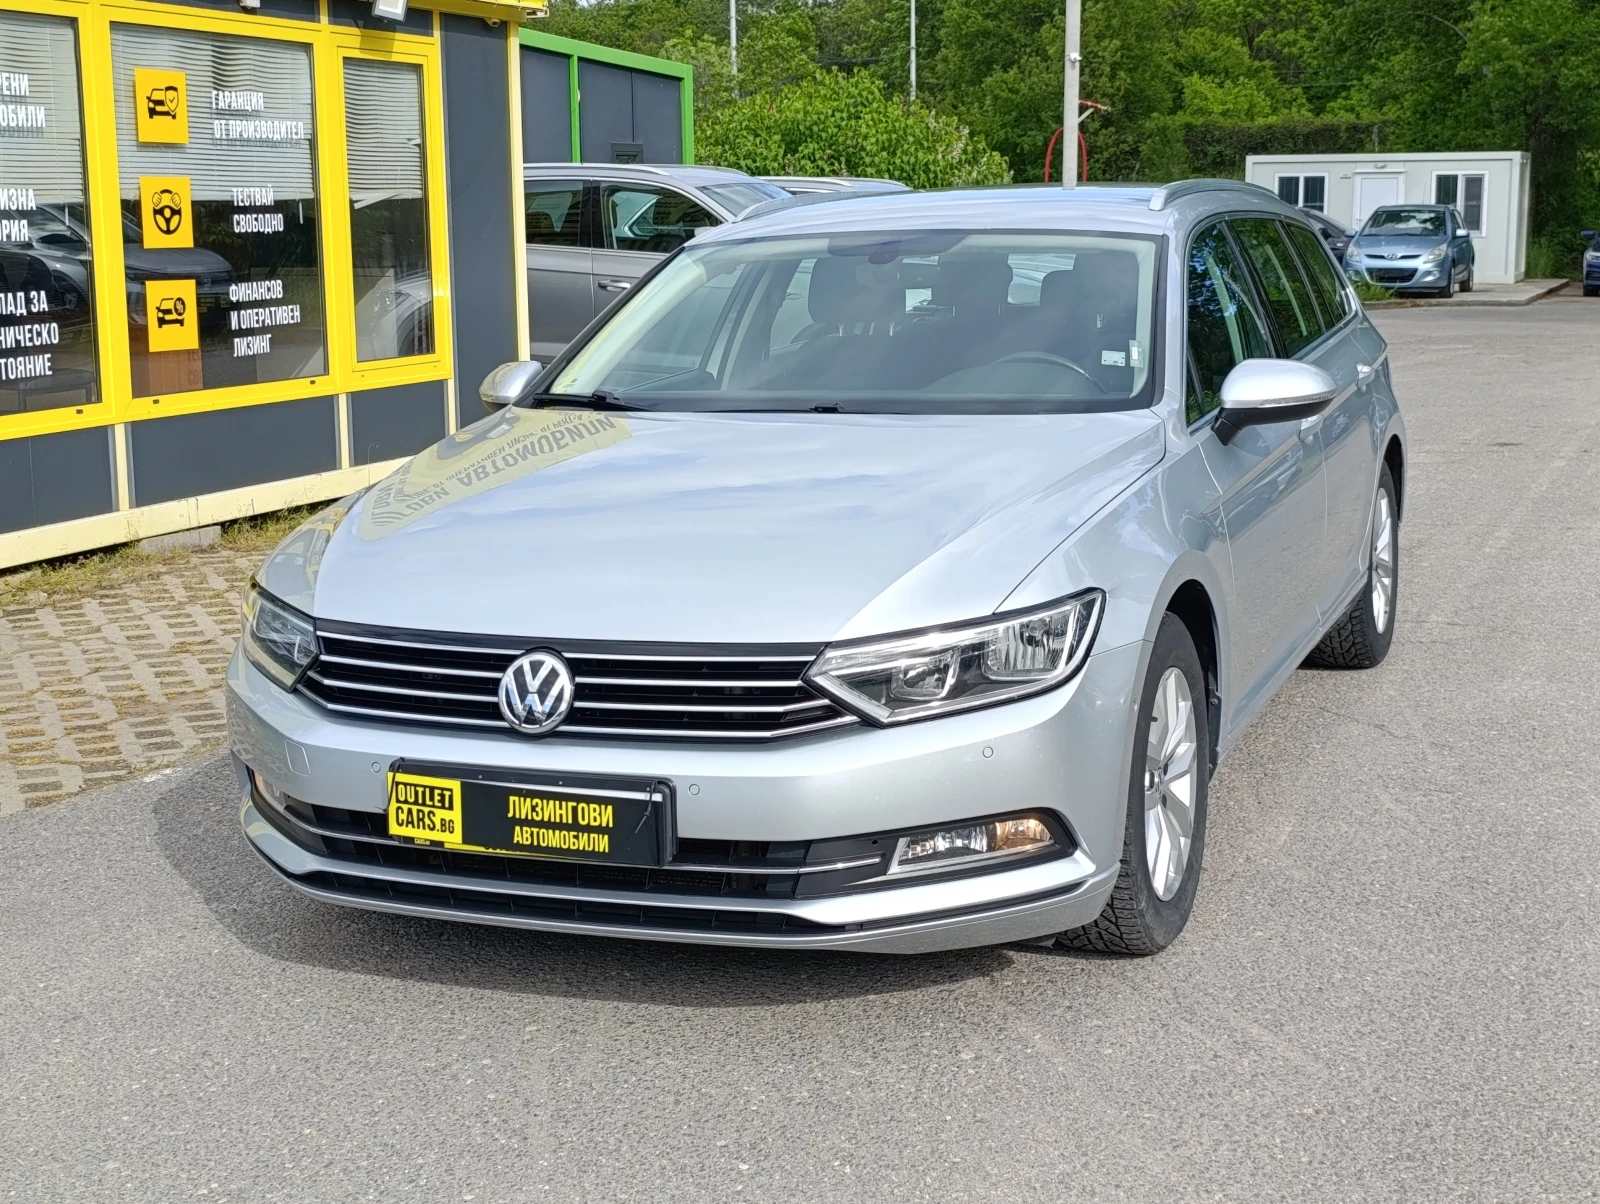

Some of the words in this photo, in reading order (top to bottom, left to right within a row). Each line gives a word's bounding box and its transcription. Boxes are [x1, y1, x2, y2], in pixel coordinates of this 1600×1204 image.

[212, 90, 264, 112] ГАРАНЦИЯ
[214, 120, 227, 139] ОТ
[229, 120, 304, 140] ПРОИЗВОДИТЕЛ
[232, 184, 275, 206] ТЕСТВАЙ
[0, 219, 29, 242] РИЯ
[233, 213, 284, 234] СВОБОДНО
[30, 290, 49, 313] ЗА
[228, 279, 284, 302] ФИНАНСОВ
[230, 310, 239, 330] И
[240, 304, 301, 330] ОПЕРАТИВЕН
[233, 333, 272, 358] ЛИЗИНГ
[397, 783, 452, 808] OUTLET
[394, 806, 455, 834] CARS.BG
[507, 795, 613, 828] ЛИЗИНГОВИ
[513, 825, 610, 853] АВТОМОБИЛИ
